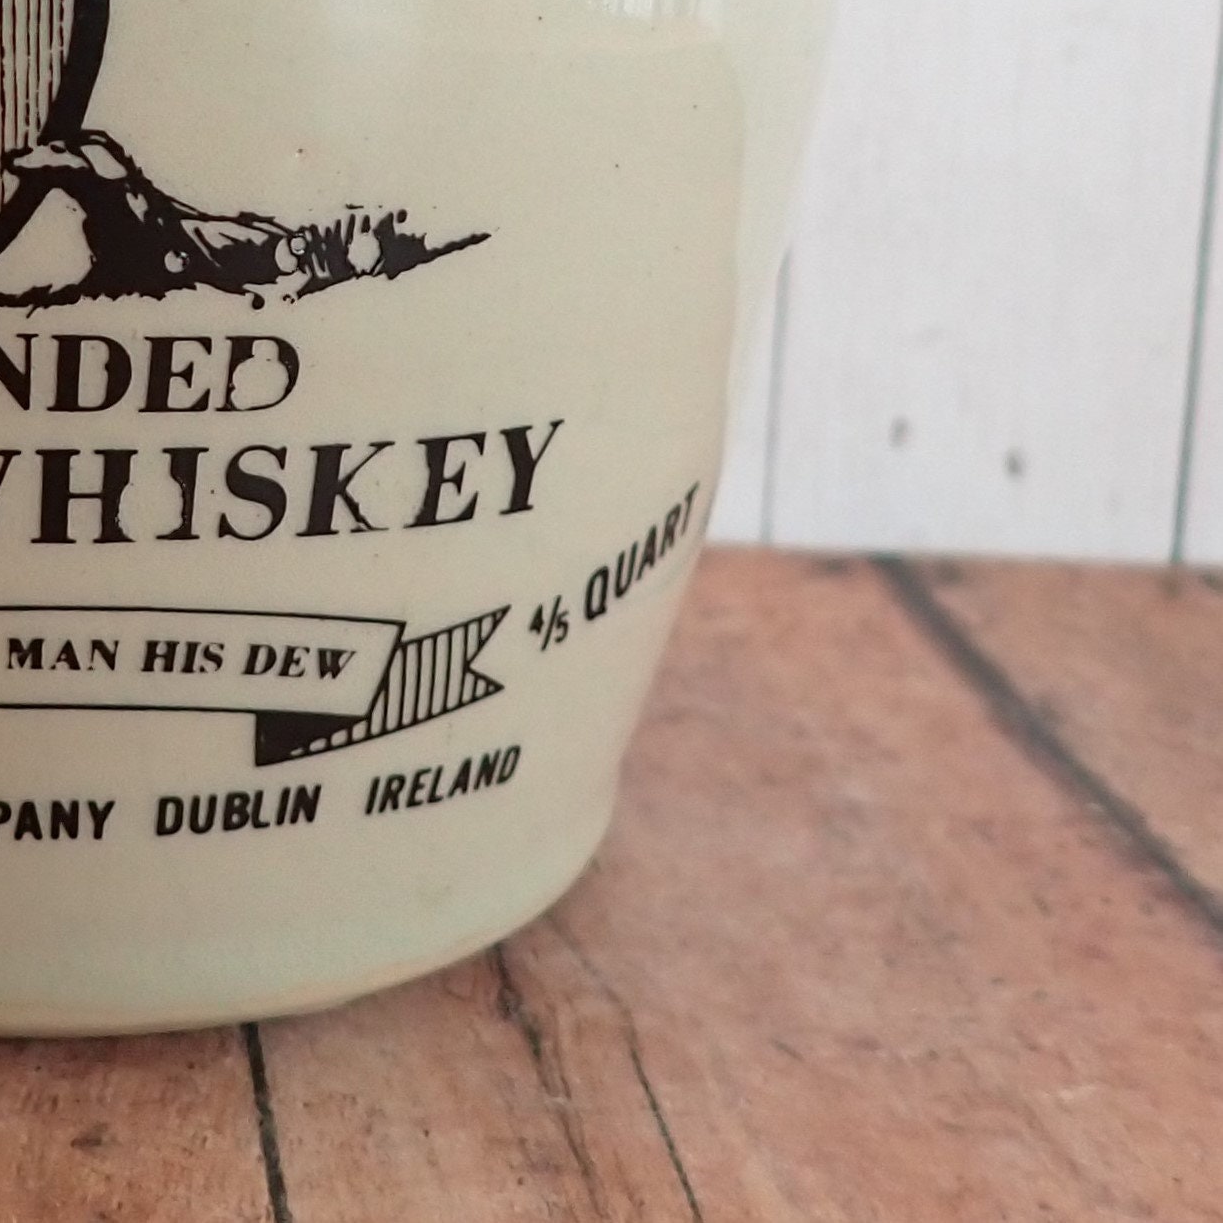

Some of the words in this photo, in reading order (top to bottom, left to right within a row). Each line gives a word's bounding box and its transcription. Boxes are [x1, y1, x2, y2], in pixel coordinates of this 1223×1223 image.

[528, 594, 570, 652] 4/5
[584, 481, 700, 620] QUART
[6, 637, 121, 672] MAN
[140, 639, 224, 674] HIS
[241, 643, 357, 680] DEW
[155, 784, 322, 836] DUBLIN
[364, 744, 521, 815] IRELAND
